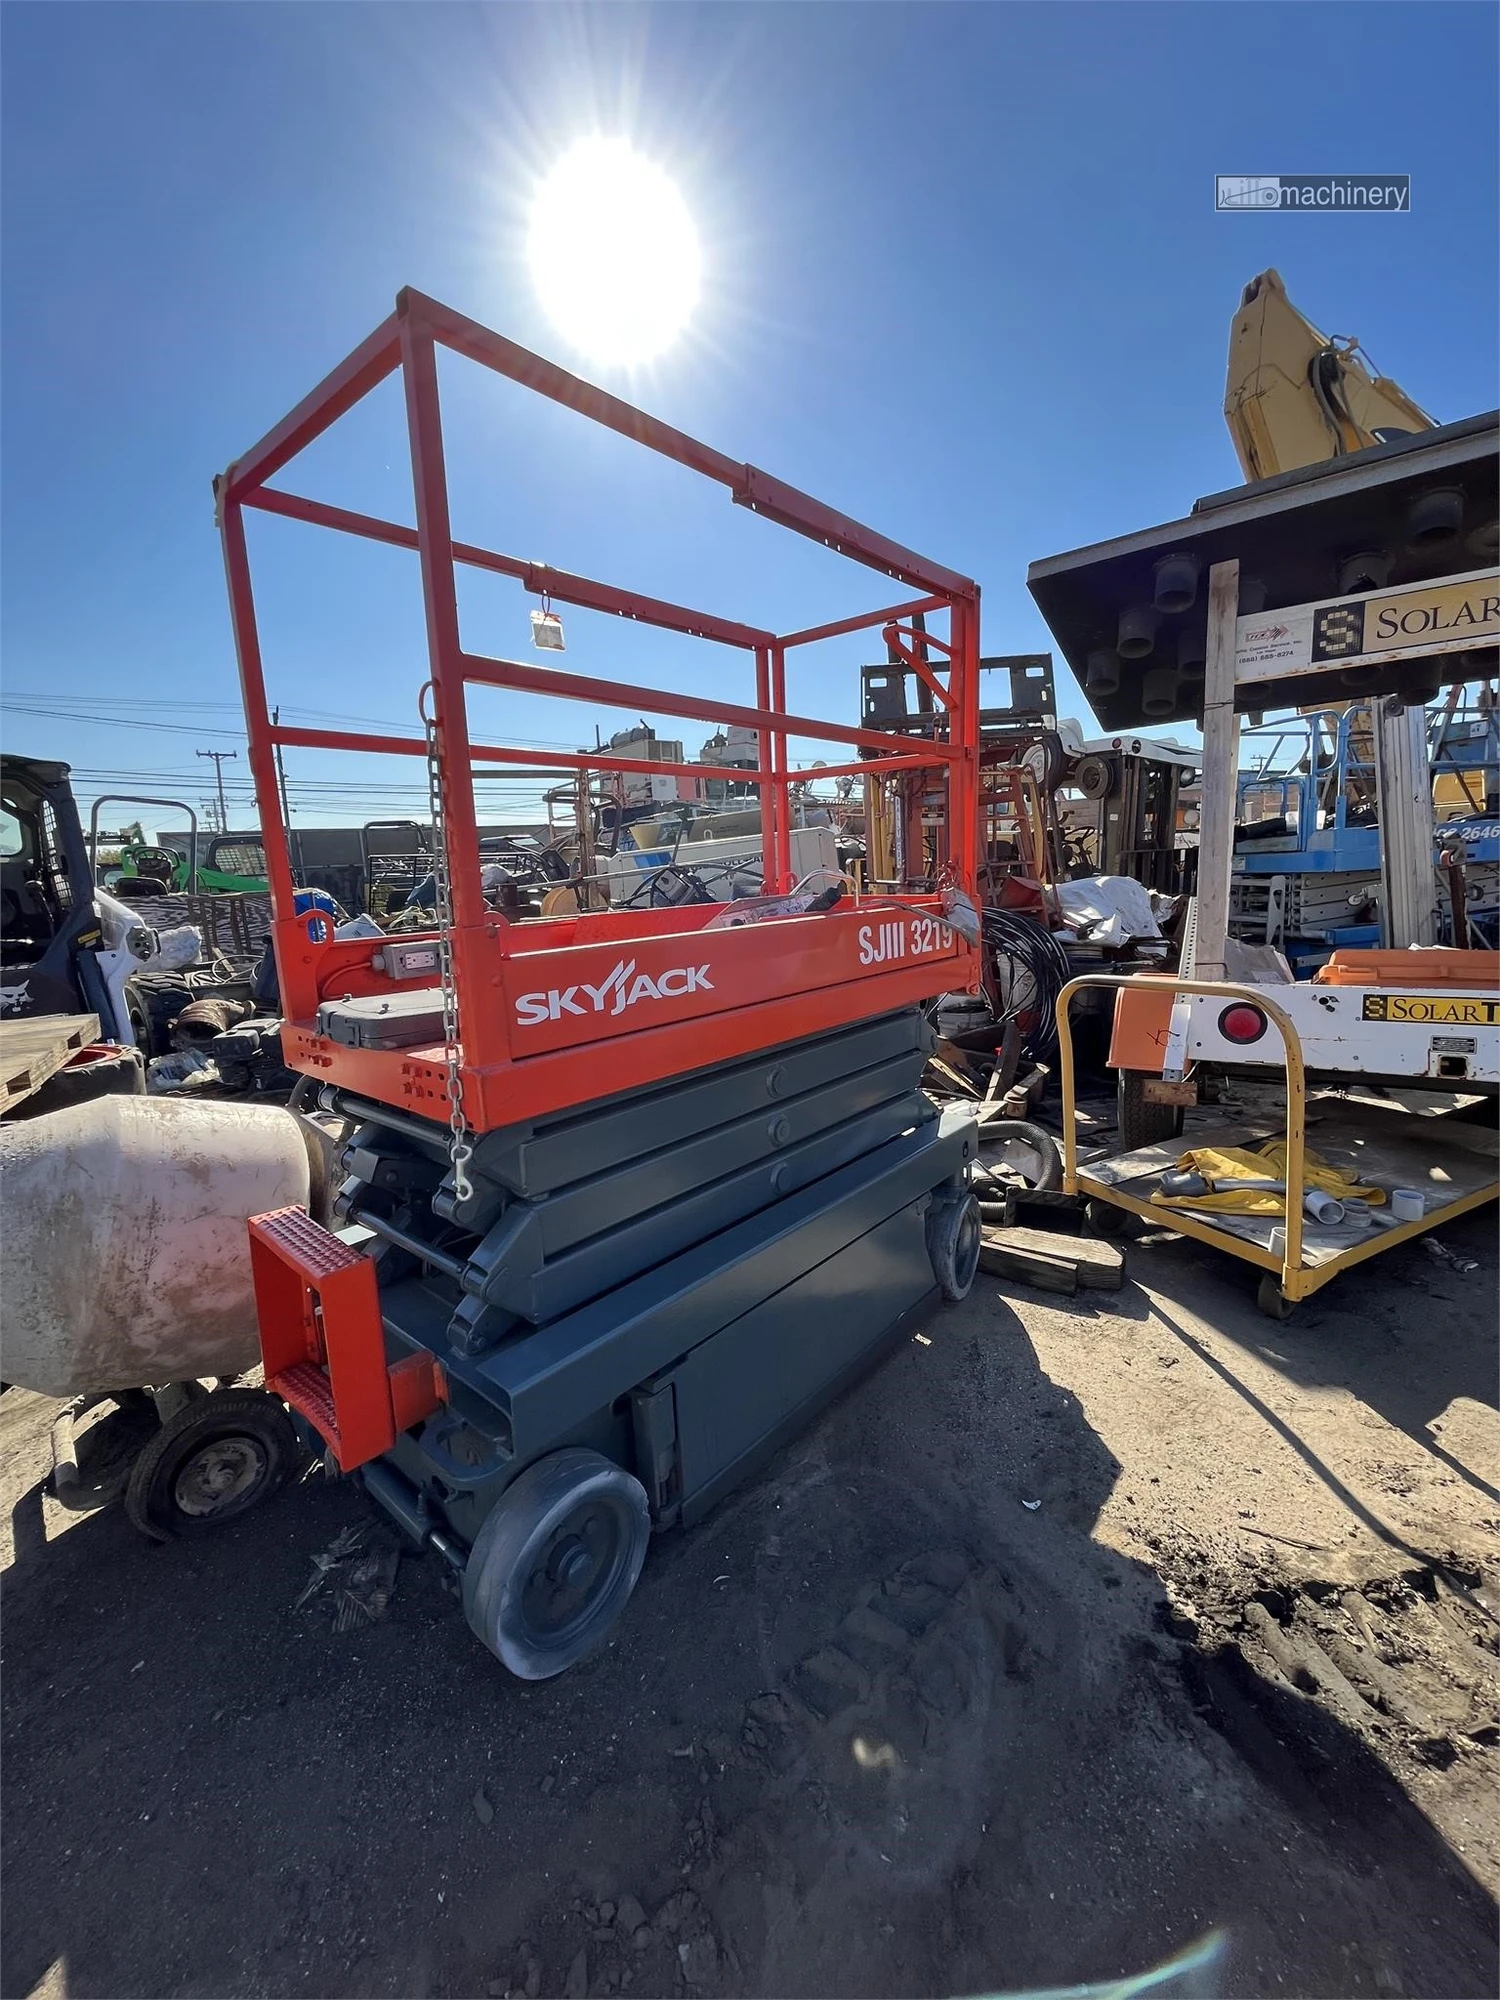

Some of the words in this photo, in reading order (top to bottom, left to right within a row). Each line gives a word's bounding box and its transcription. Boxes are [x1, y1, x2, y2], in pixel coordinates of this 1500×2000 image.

[858, 921, 905, 965] SJIII
[910, 918, 953, 955] 3219
[515, 958, 715, 1026] SKYJACK
